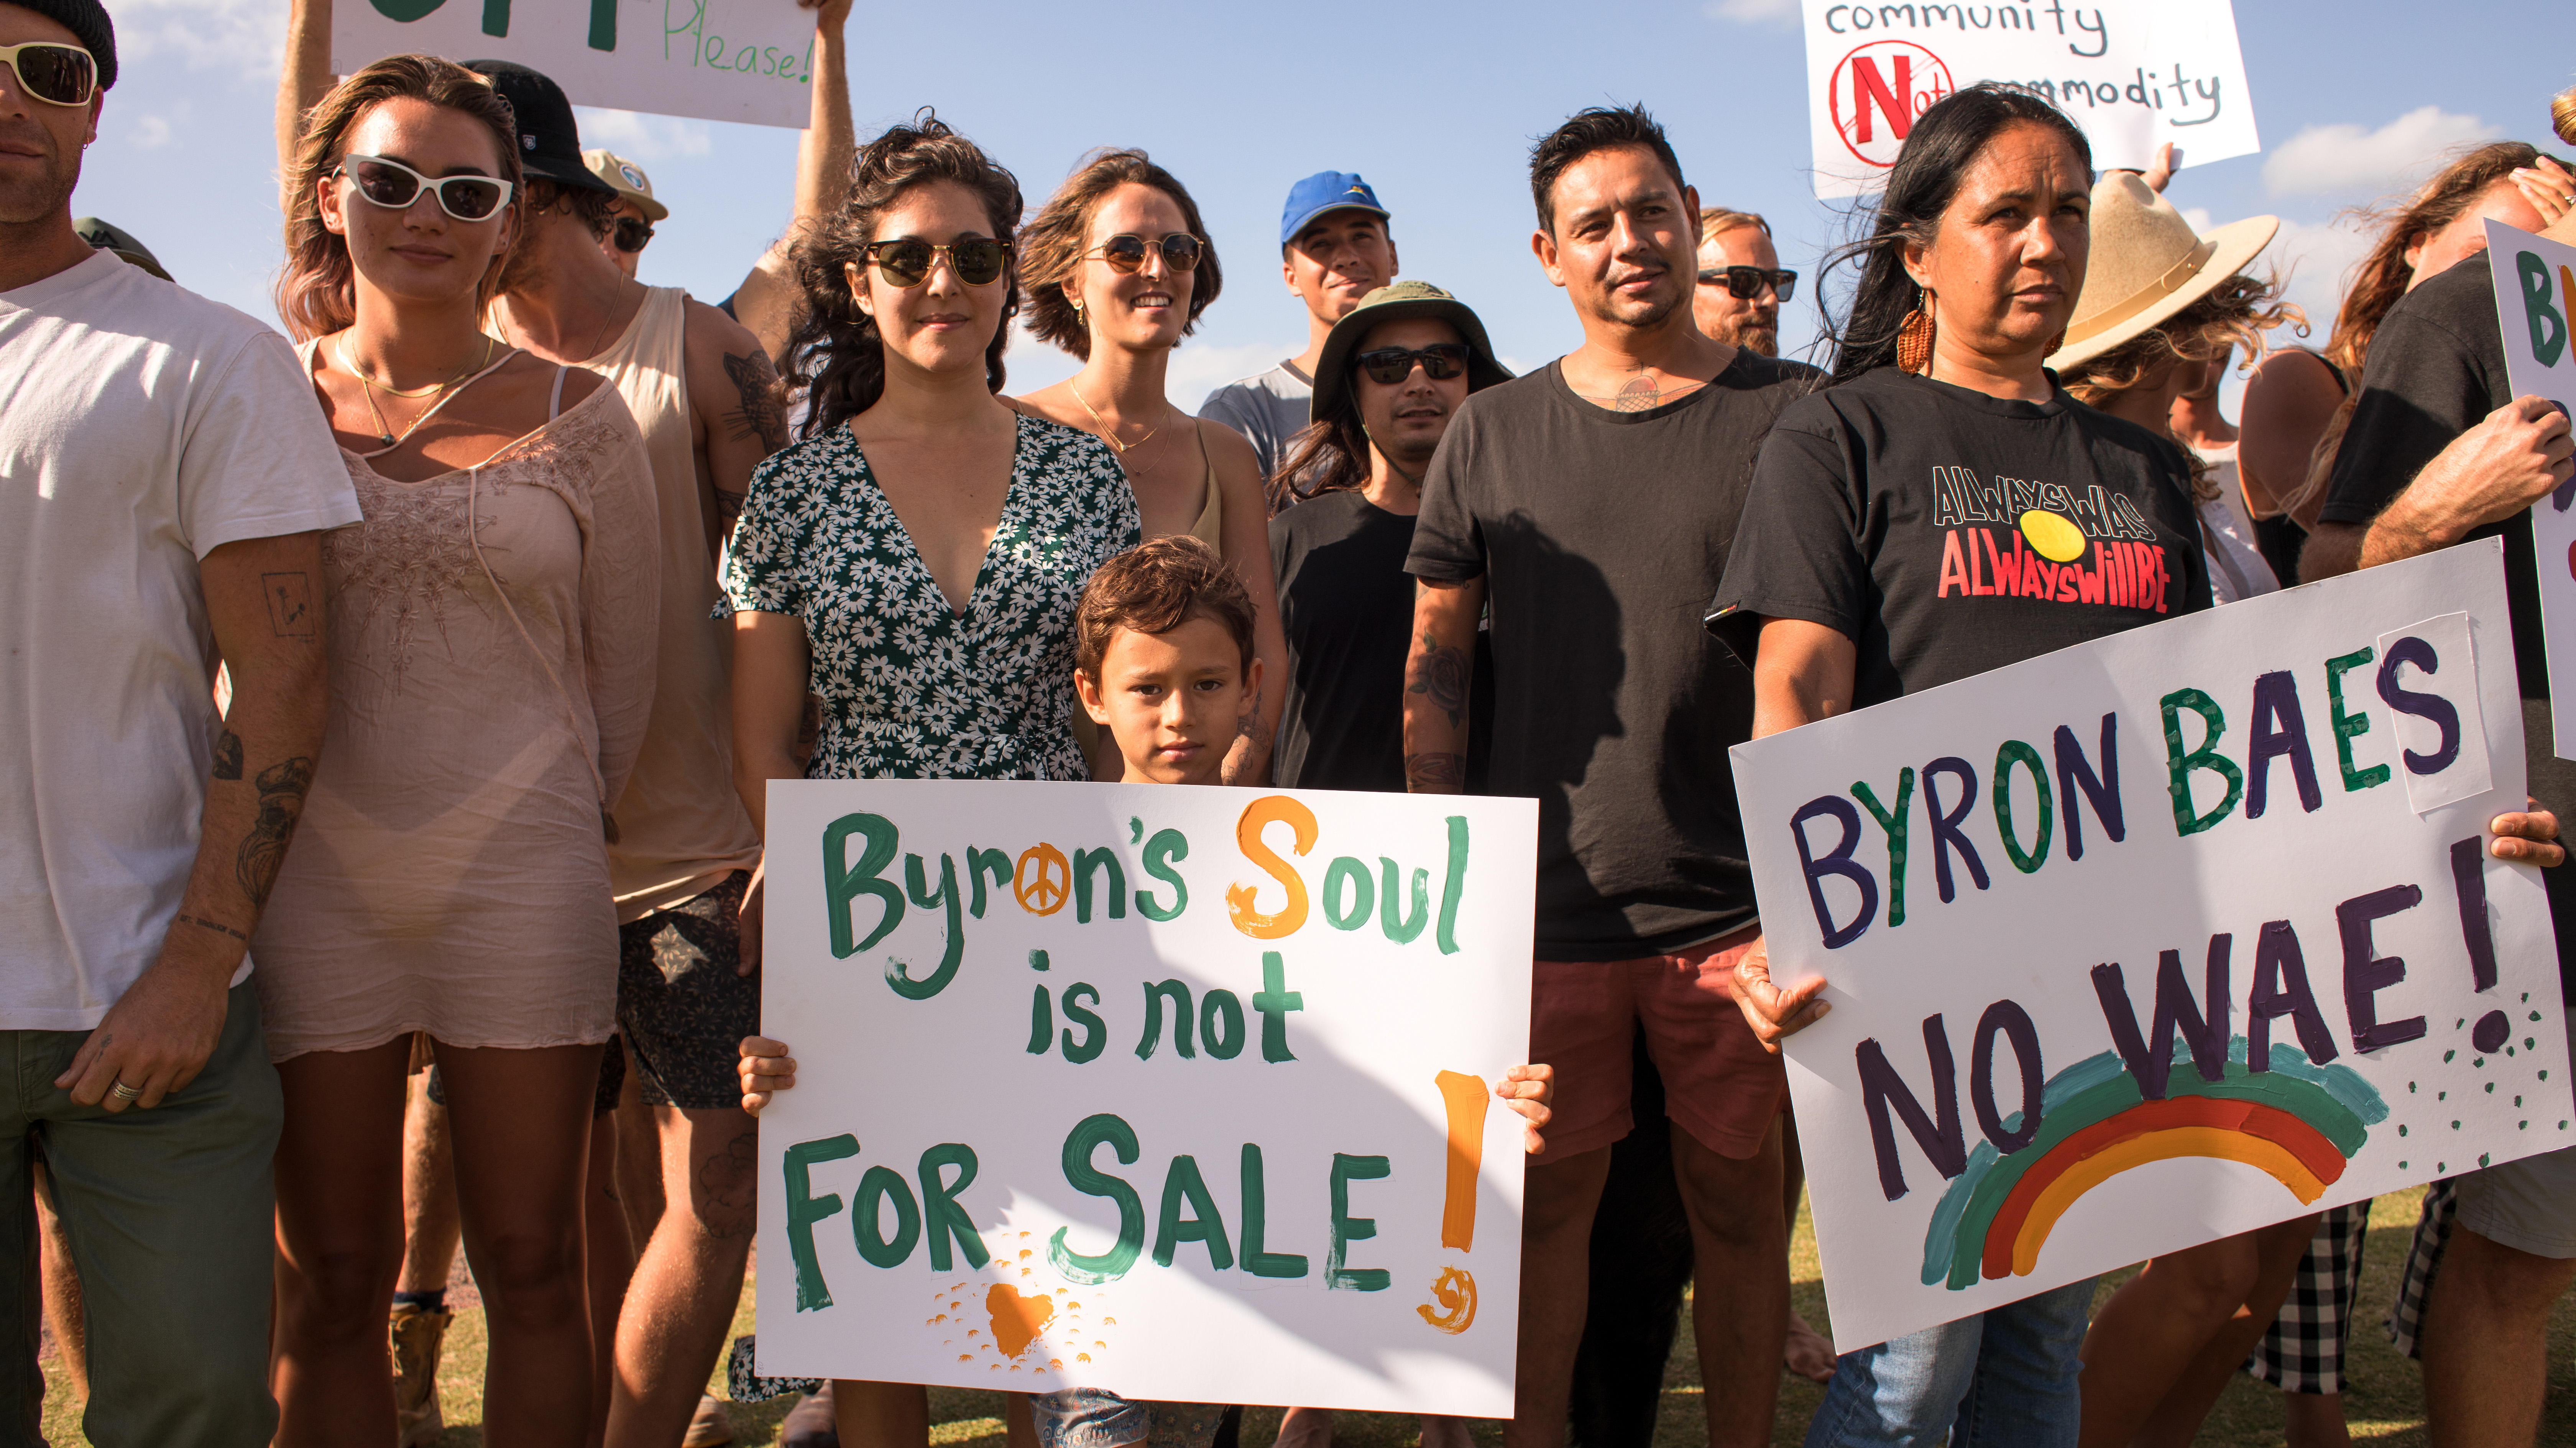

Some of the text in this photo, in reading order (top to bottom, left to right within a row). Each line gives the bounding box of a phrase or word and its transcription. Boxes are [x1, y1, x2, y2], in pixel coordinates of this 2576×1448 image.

[664, 0, 814, 83] Please!
[1826, 0, 2108, 57] community
[1933, 466, 2157, 541] ALWAYS WAS
[1937, 527, 2078, 602] ALWAYS
[1790, 636, 2461, 949] BYRON BAES
[1225, 795, 1469, 955] Soul
[1025, 949, 1304, 1064] is not
[1855, 998, 2045, 1202] NO
[783, 1132, 991, 1313] FOR
